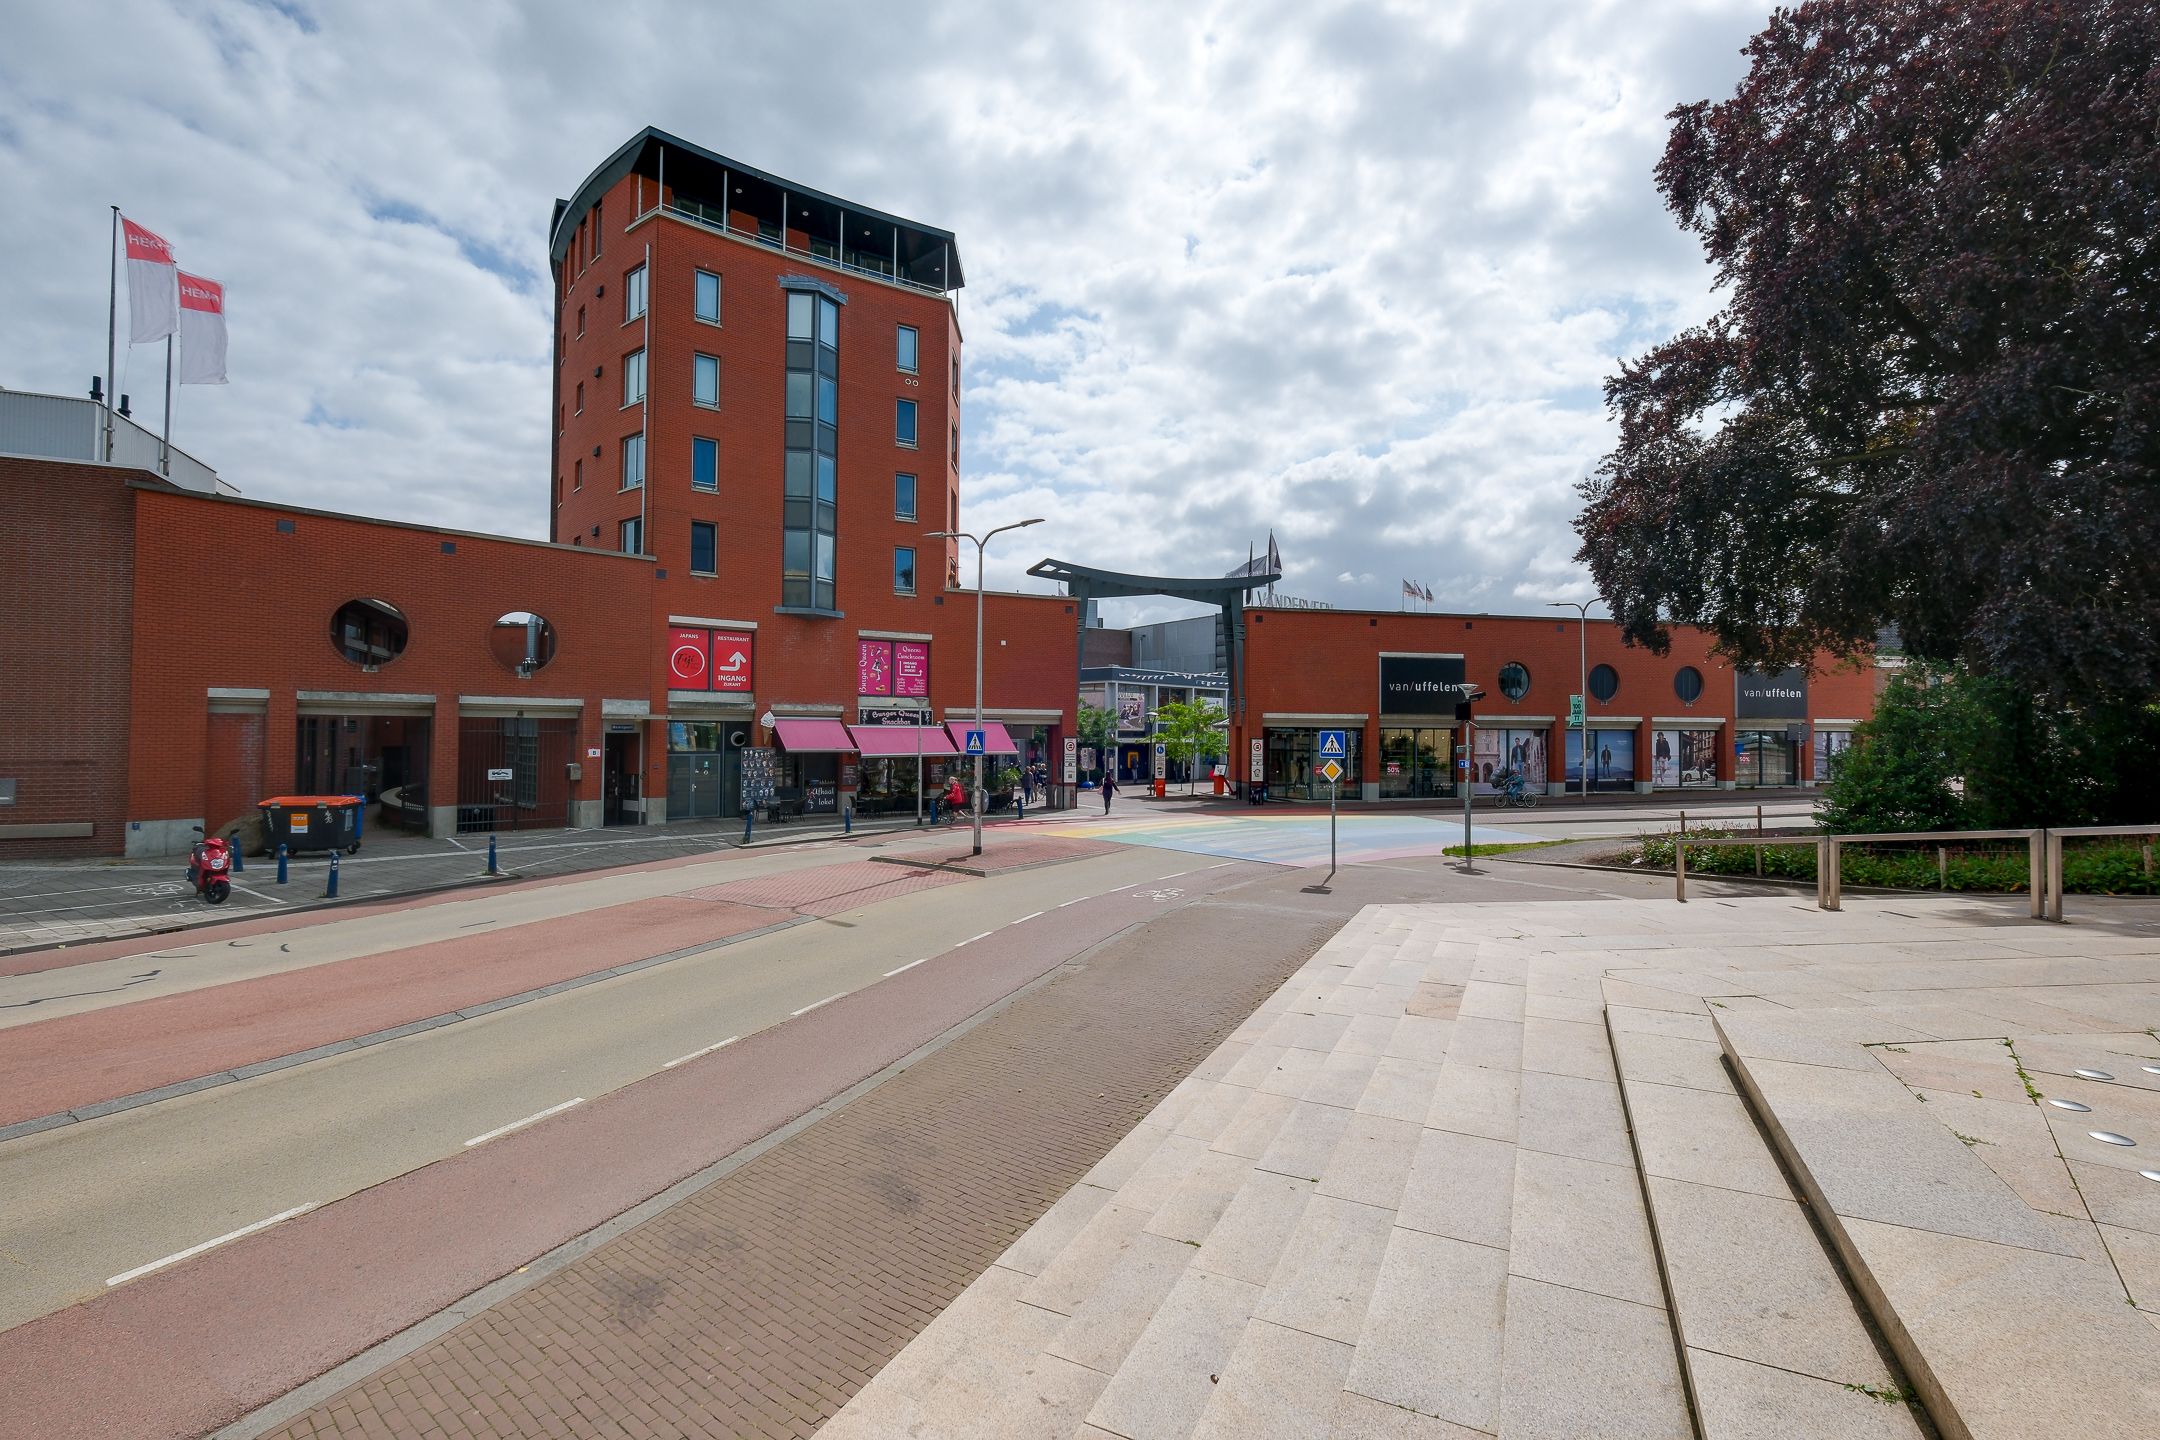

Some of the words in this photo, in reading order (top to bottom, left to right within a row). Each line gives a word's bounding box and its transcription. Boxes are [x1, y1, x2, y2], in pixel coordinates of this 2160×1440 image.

[859, 644, 868, 667] Queen
[859, 669, 868, 693] Burger
[1389, 681, 1458, 692] van/uffelen
[1744, 688, 1802, 698] van/uffelen
[881, 717, 911, 725] Snackbar
[813, 787, 834, 795] Afhaal
